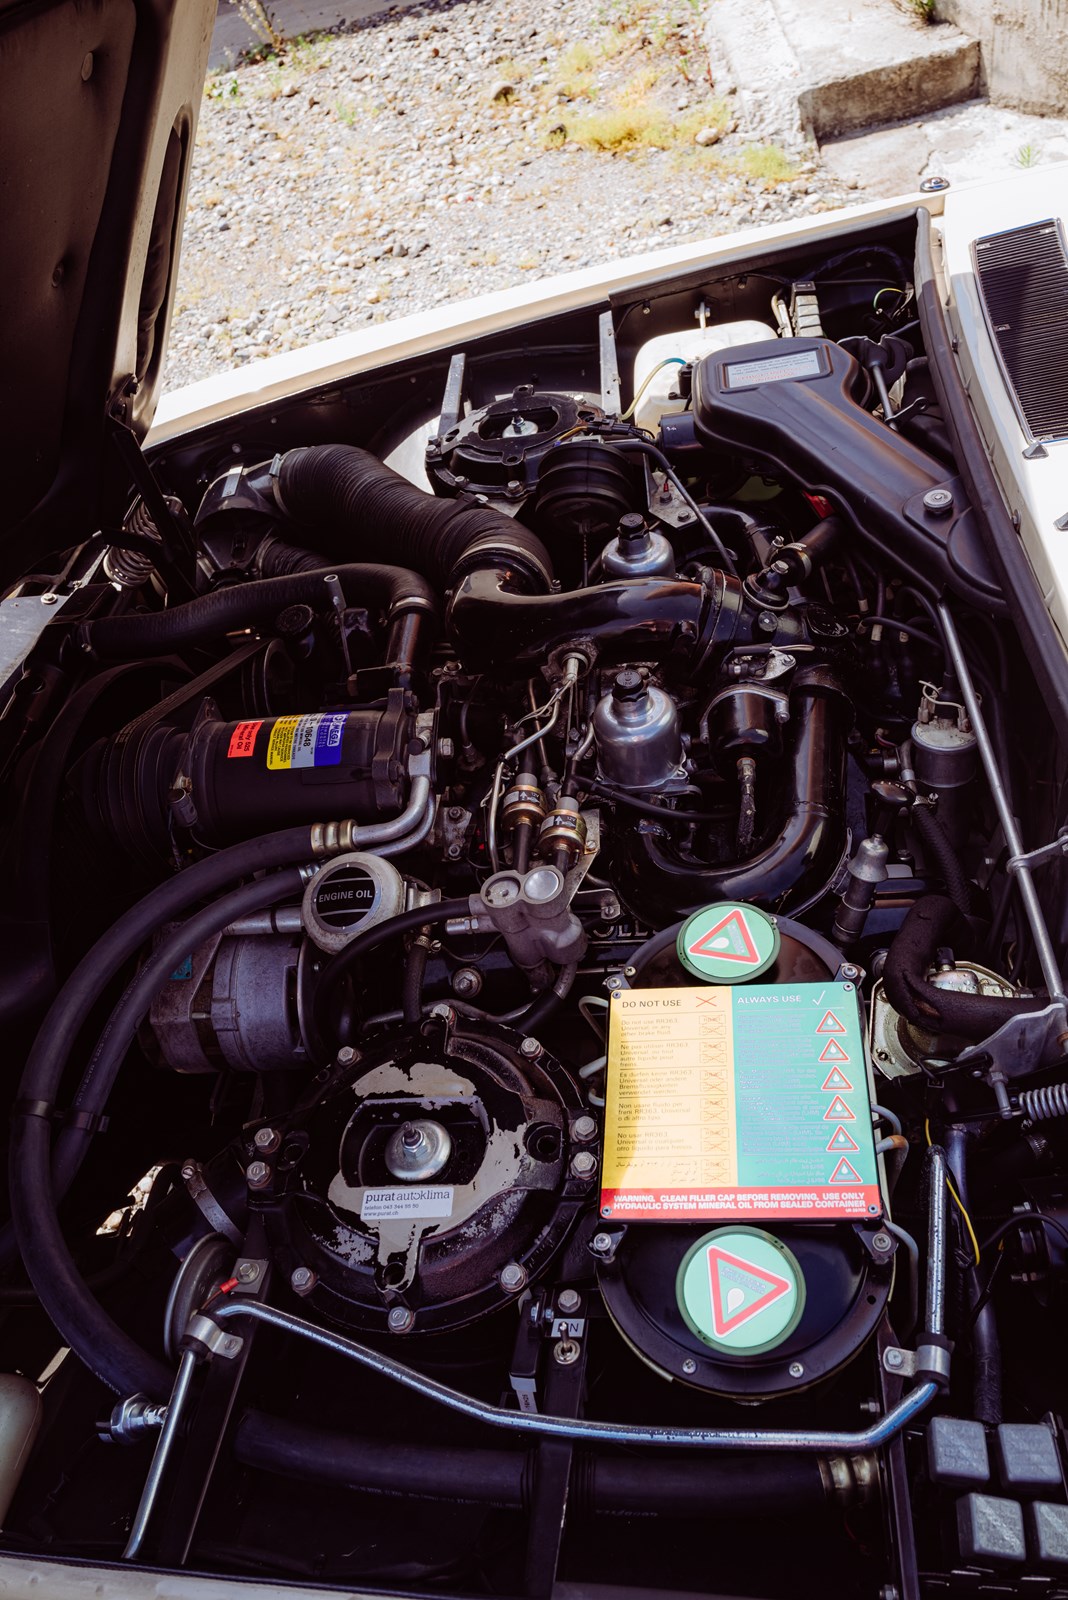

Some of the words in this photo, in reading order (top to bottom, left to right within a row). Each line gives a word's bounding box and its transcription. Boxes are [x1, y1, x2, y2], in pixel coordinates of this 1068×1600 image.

[238, 724, 250, 740] Mineral
[245, 730, 253, 740] only
[319, 890, 354, 903] ENGINE
[355, 890, 373, 898] OIL
[622, 1000, 636, 1008] DO
[737, 995, 779, 1004] ALWAYS
[781, 994, 801, 1002] USE
[365, 1192, 395, 1204] purat
[396, 1190, 450, 1200] autoklima
[689, 1194, 716, 1202] FILLER
[737, 1193, 769, 1201] BEFORE
[841, 1192, 865, 1200] ONLY
[614, 1202, 661, 1210] HYDRAULIC
[698, 1201, 736, 1209] MINERAL
[738, 1201, 752, 1209] OIL
[754, 1201, 779, 1209] FROM
[815, 1200, 866, 1208] CONTAINER
